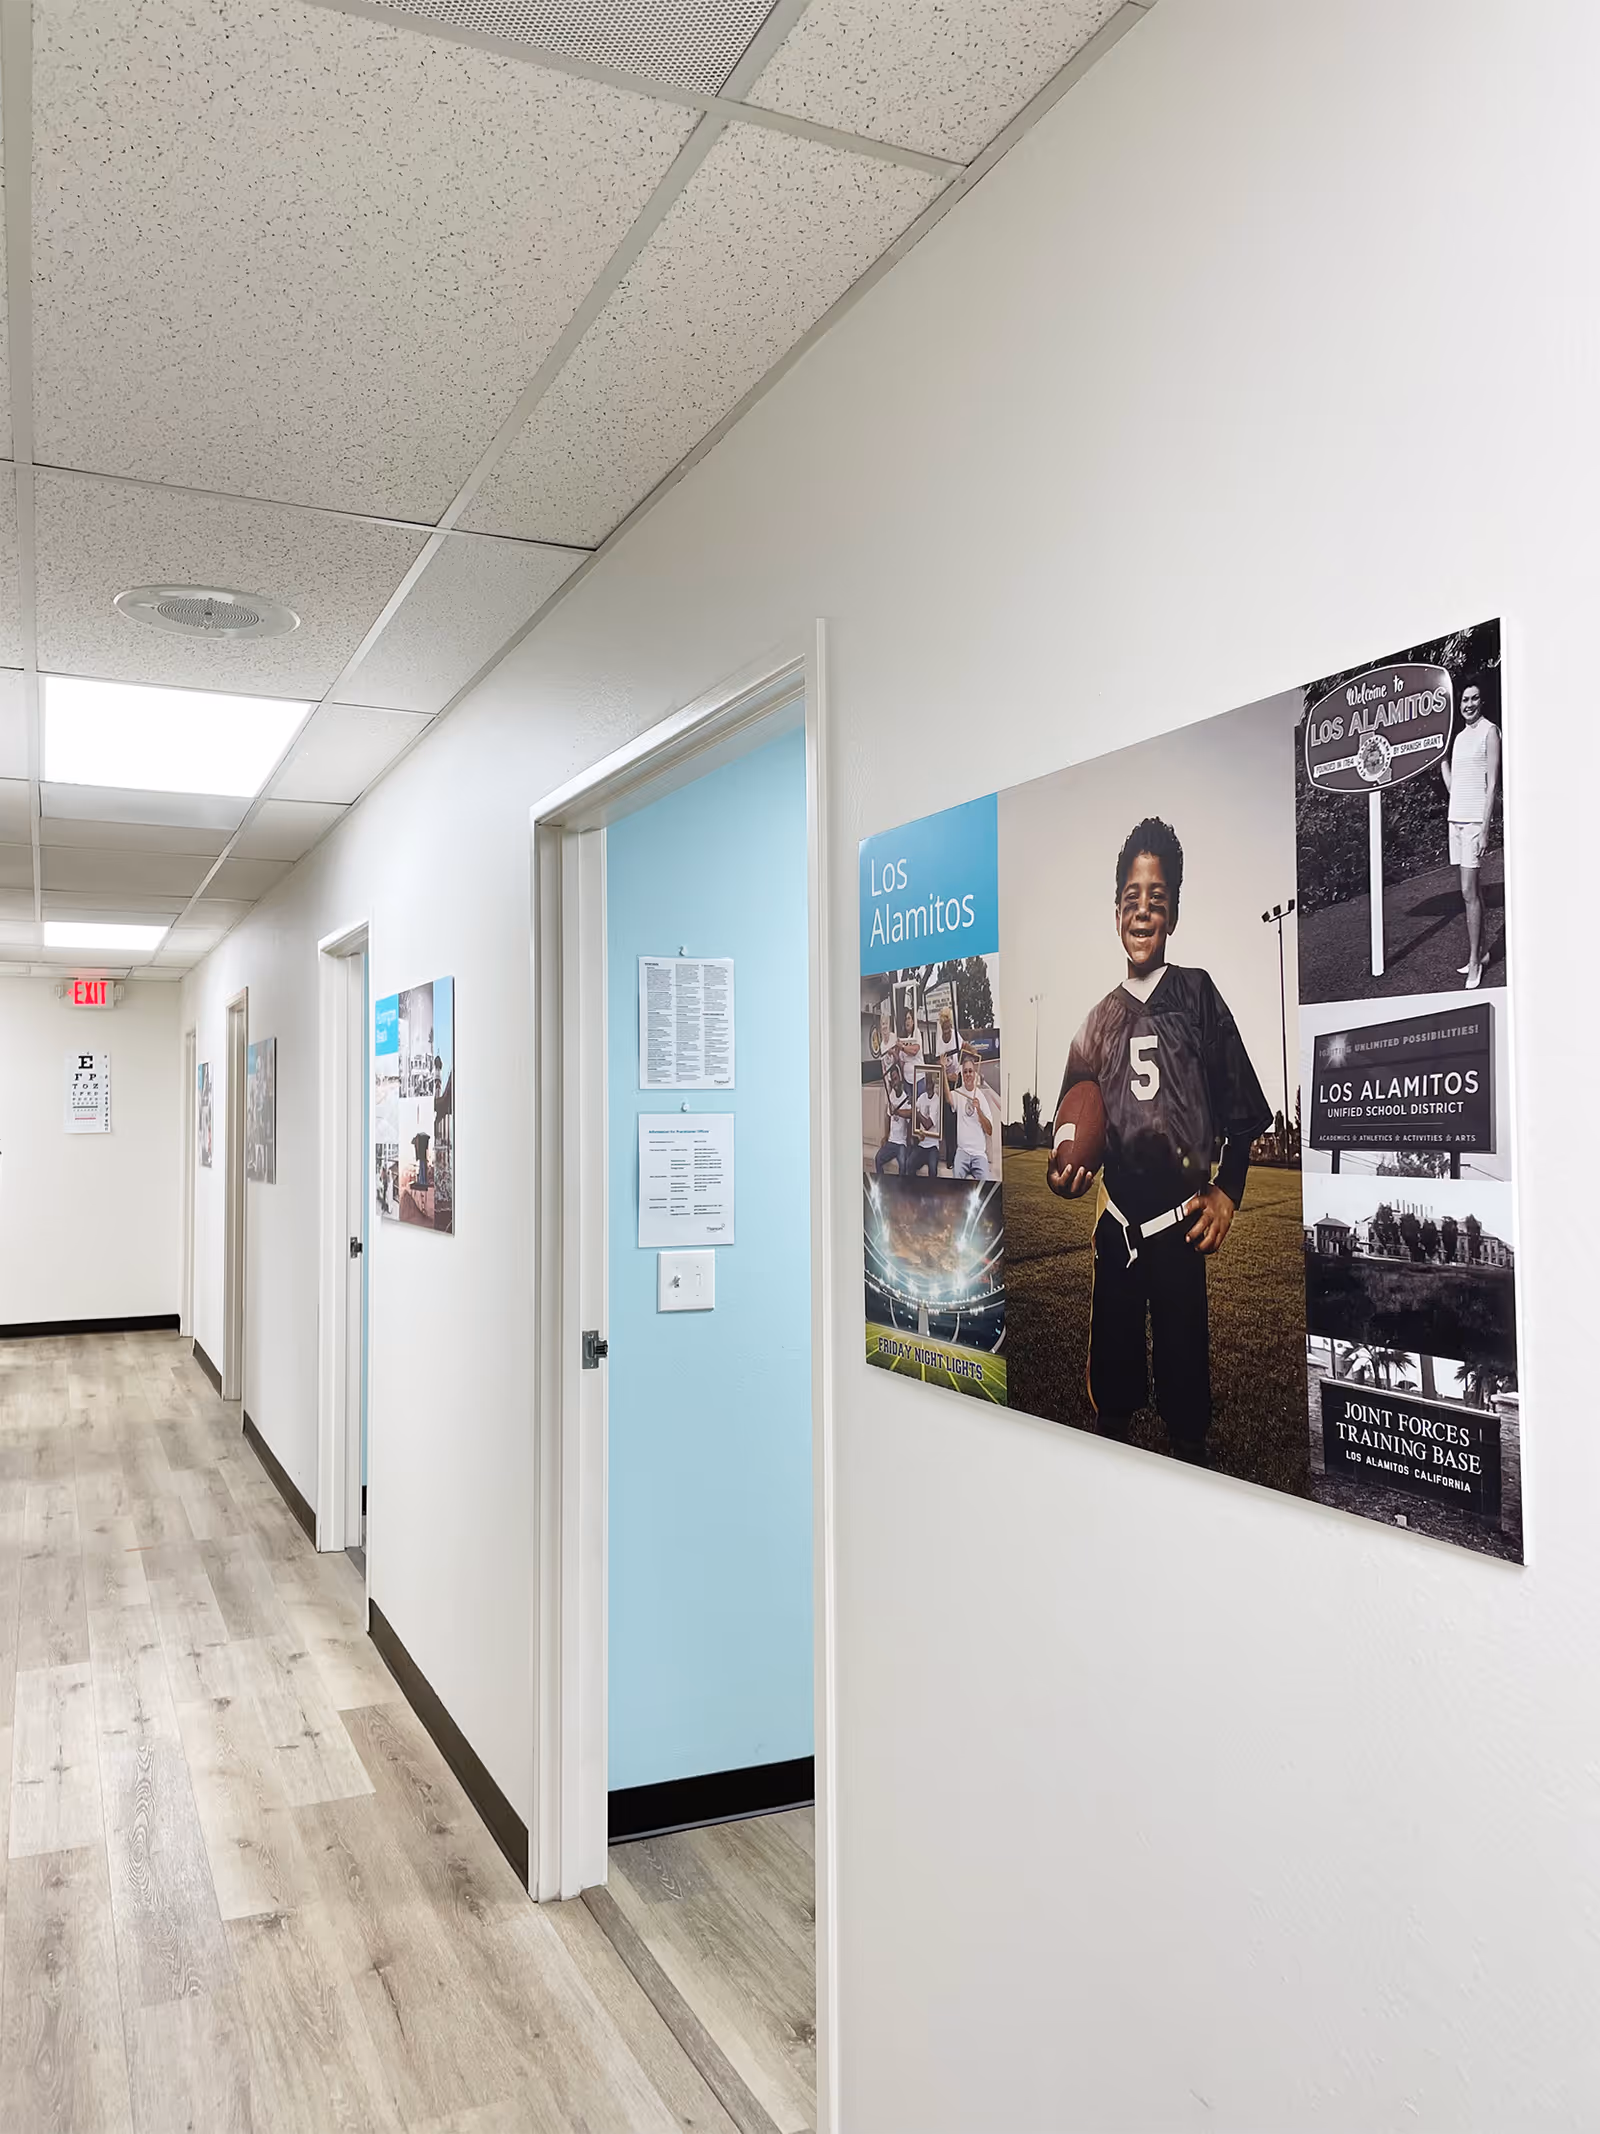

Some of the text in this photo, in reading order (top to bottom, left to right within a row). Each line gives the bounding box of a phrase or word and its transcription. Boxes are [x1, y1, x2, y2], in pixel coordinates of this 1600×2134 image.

[1346, 675, 1404, 706] Welcome to
[1310, 687, 1447, 747] LOS ALAMITOS
[1393, 736, 1441, 754] BY SPANISH GRANT
[1316, 761, 1337, 774] FOUNDED
[870, 856, 908, 898] Los
[869, 893, 975, 948] Alamitos
[74, 981, 108, 1004] EXIT
[1354, 1038, 1399, 1052] UNLIMITED
[1402, 1025, 1479, 1045] POSSIBILITIES!
[78, 1055, 93, 1069] E
[1129, 1035, 1161, 1101] 5
[1320, 1070, 1479, 1103] LOS ALAMITOS
[1327, 1101, 1464, 1118] UNIFIED SCHOOL DISTRICT
[1319, 1134, 1476, 1142] ACADEMICS ATHLETICS ACTIVITIES ARTS
[878, 1337, 983, 1380] FRIDAY NIGHT LIGHTS
[1344, 1401, 1471, 1447] JOINT FORCES
[1336, 1421, 1482, 1475] TRAINING BASE
[1345, 1450, 1472, 1493] LOS ALAMITOS CALIFORNIA
